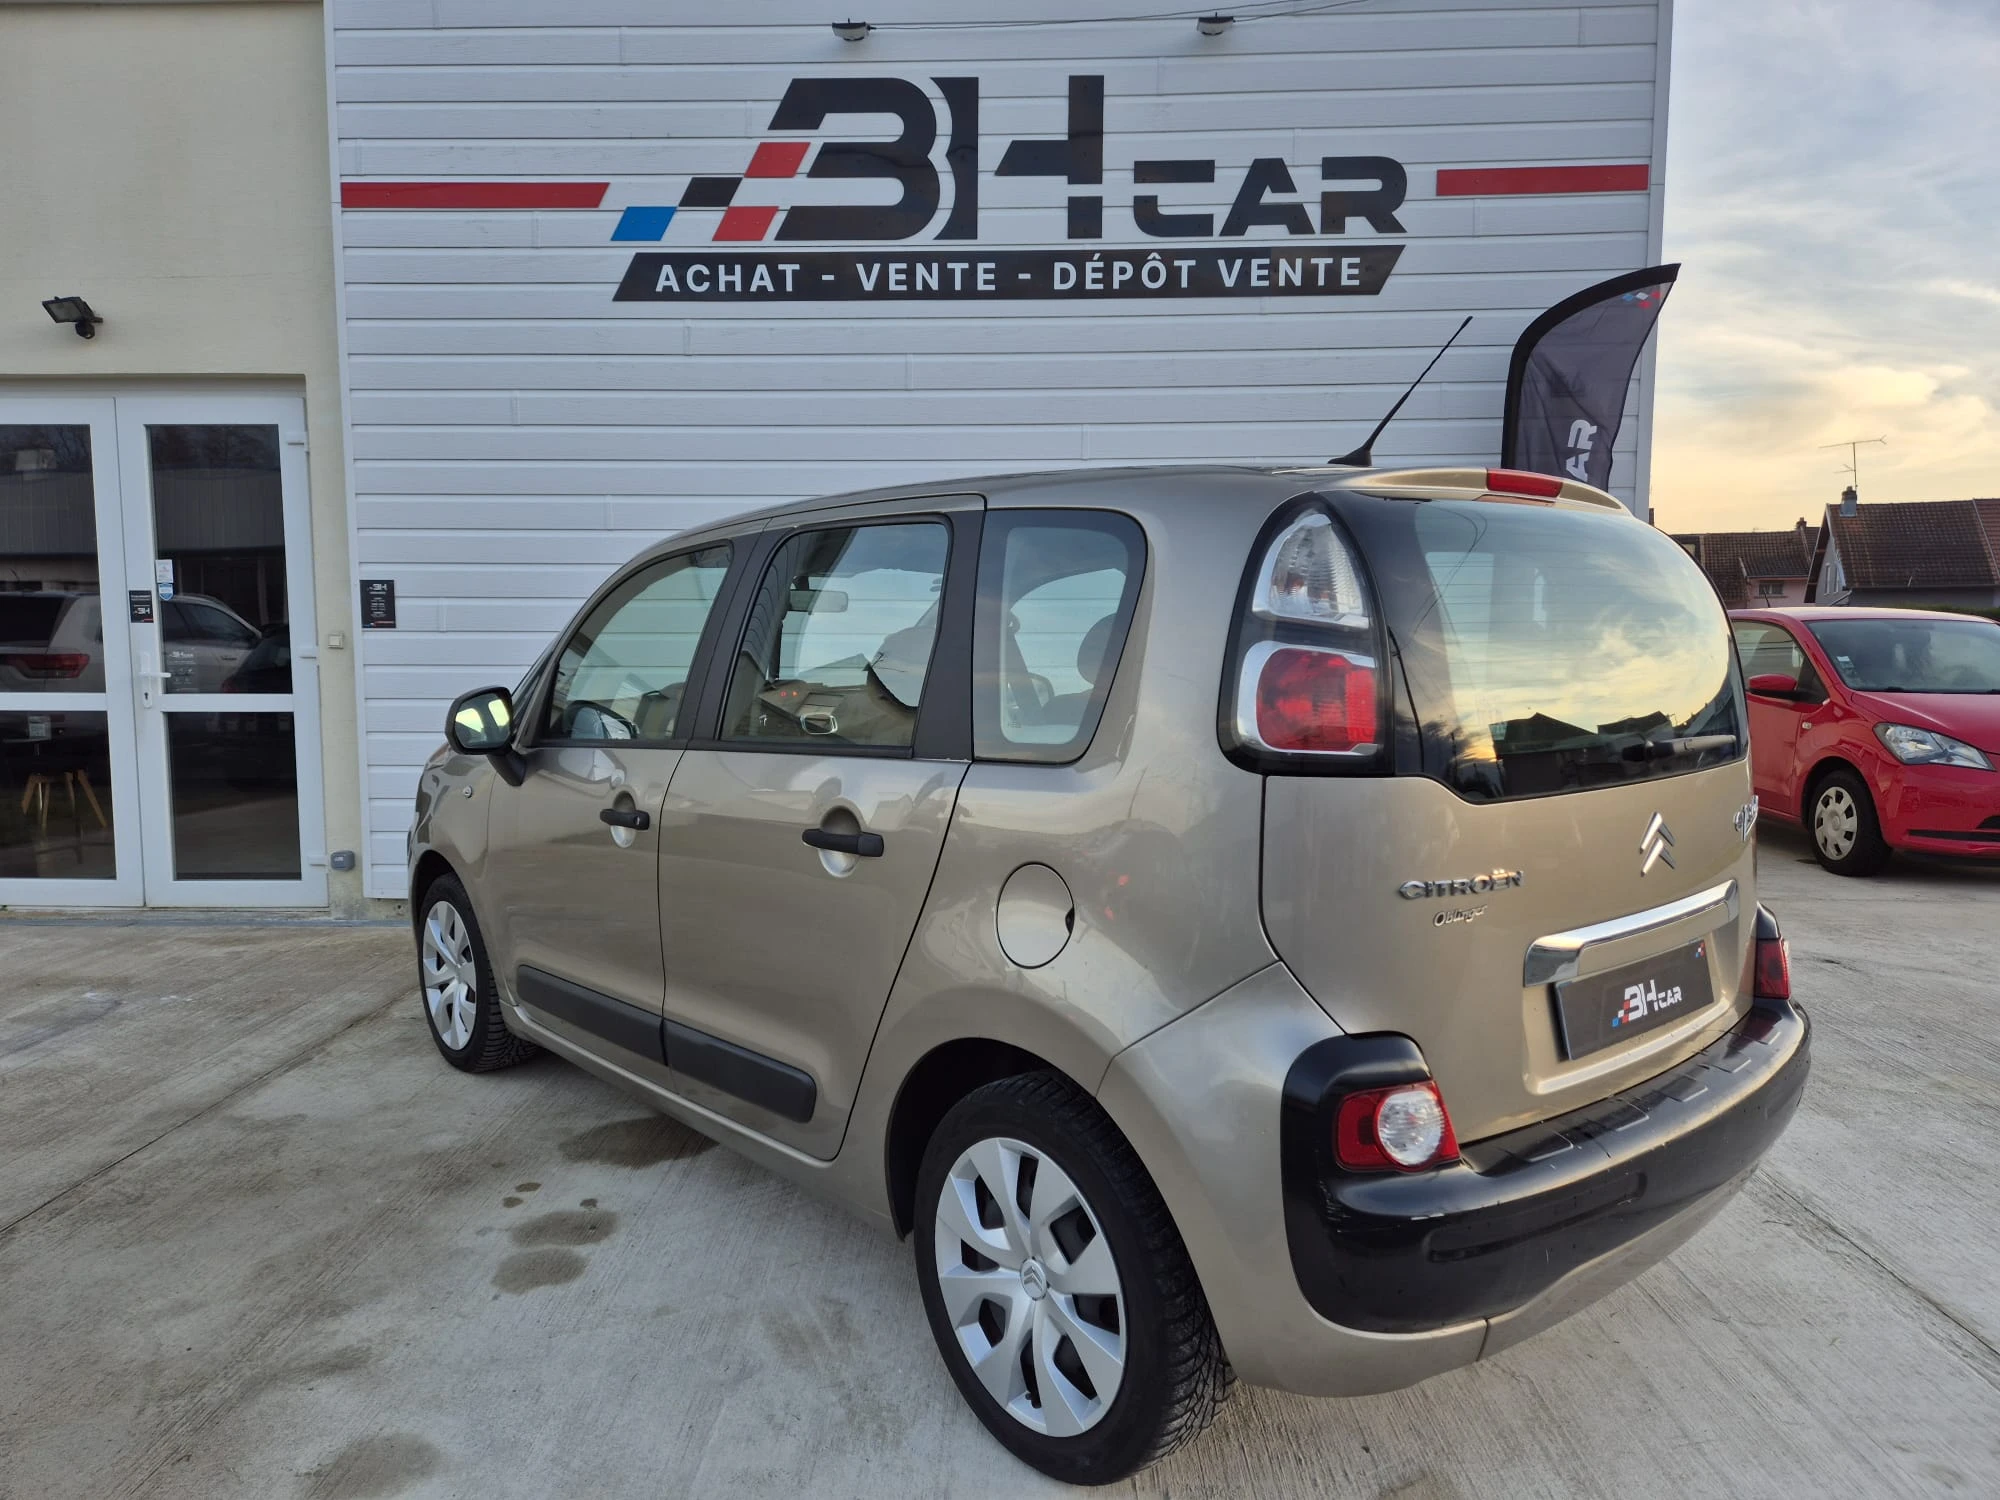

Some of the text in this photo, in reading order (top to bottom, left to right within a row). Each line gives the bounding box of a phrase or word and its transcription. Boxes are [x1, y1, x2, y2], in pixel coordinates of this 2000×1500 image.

[655, 264, 800, 293] ACHAT
[855, 262, 997, 292] VENTE
[1053, 252, 1197, 290] DÉPÔT
[1217, 257, 1362, 288] VENTE
[1566, 419, 1598, 482] AR
